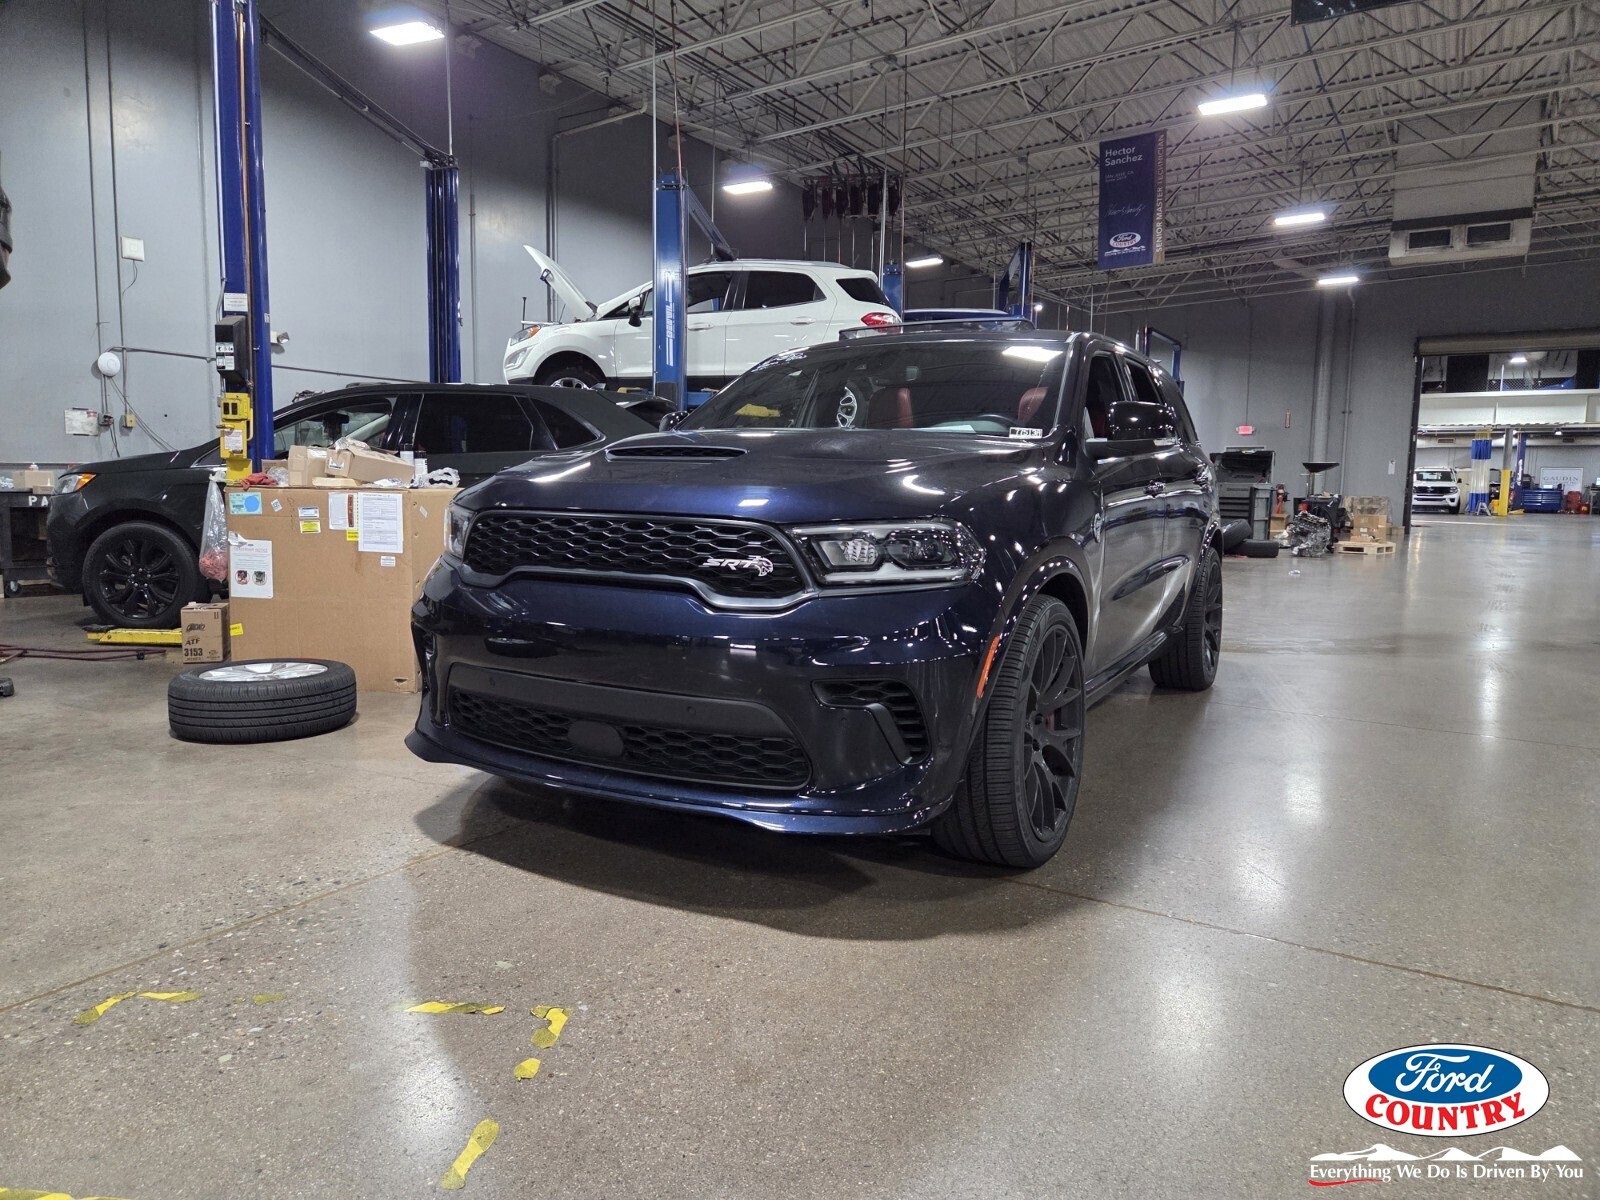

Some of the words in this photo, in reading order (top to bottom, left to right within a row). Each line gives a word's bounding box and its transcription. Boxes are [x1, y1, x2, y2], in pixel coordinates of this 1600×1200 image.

[1105, 147, 1136, 157] Hector
[1105, 154, 1143, 166] Sanchez
[1155, 187, 1163, 219] MASTER
[1155, 222, 1163, 252] SENIOR
[702, 558, 759, 571] SRT
[184, 637, 201, 646] ATF
[184, 648, 203, 657] 3153
